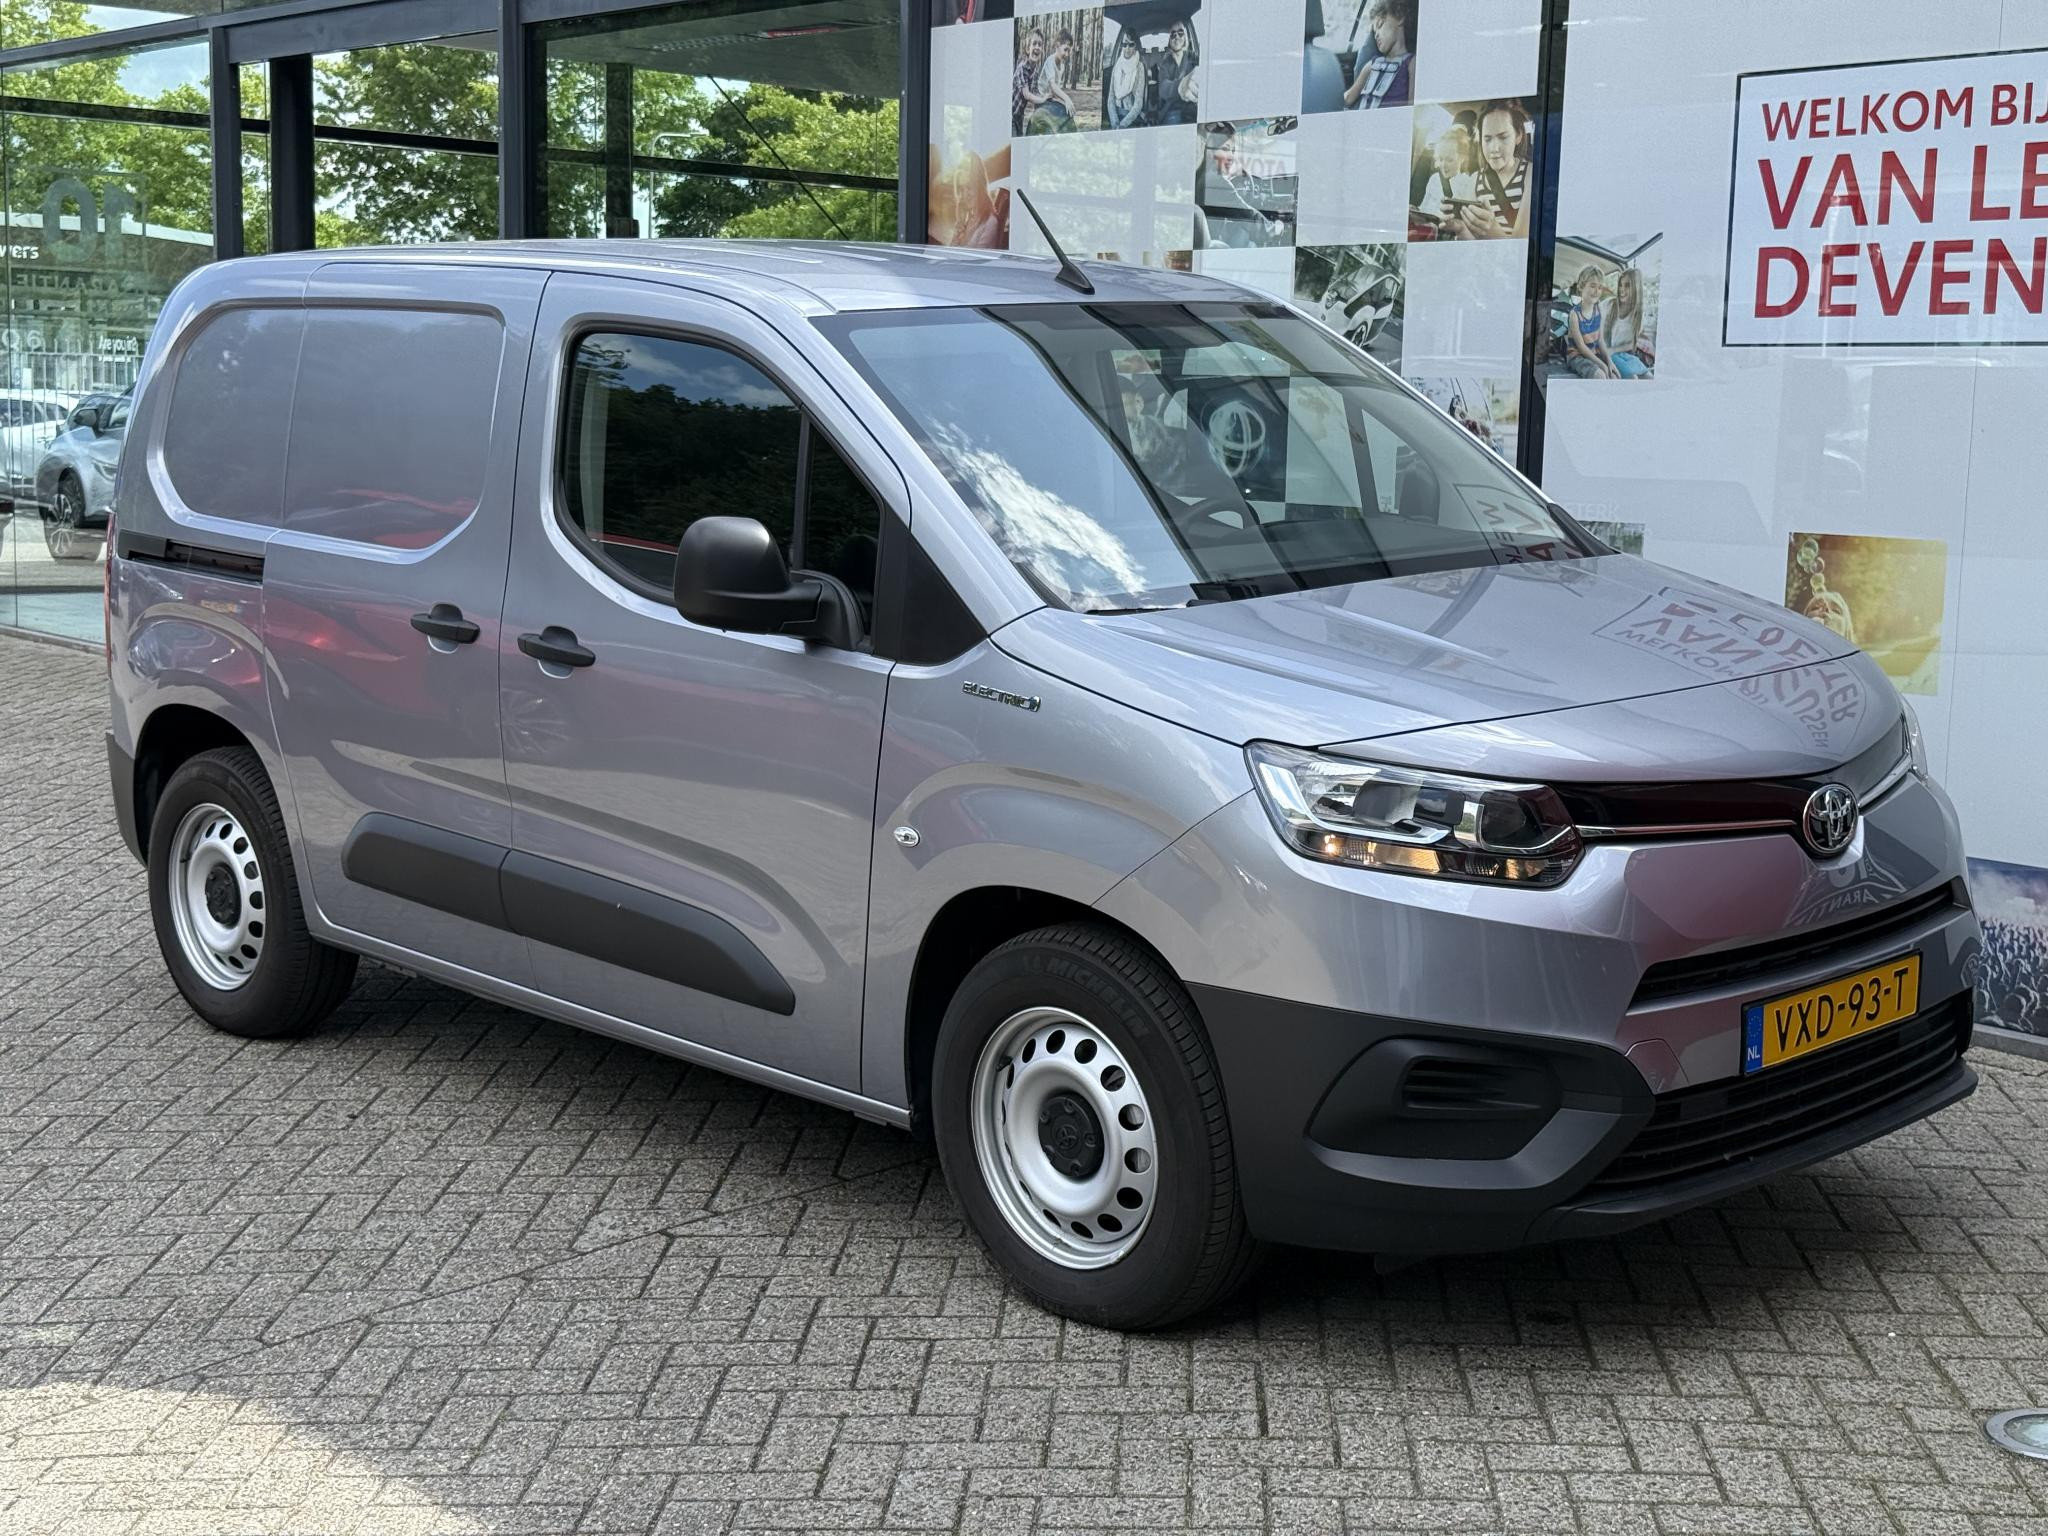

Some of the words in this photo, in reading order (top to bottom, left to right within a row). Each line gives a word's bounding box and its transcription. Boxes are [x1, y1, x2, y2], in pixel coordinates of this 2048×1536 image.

[1761, 86, 1974, 142] WELKOM
[1757, 147, 1939, 230] VAN
[1969, 141, 2048, 222] LE
[1754, 236, 2048, 319] DEVEN
[962, 680, 1031, 710] ELECTRIC
[1775, 966, 1909, 1053] VXD-93-T
[1747, 1046, 1761, 1062] NL
